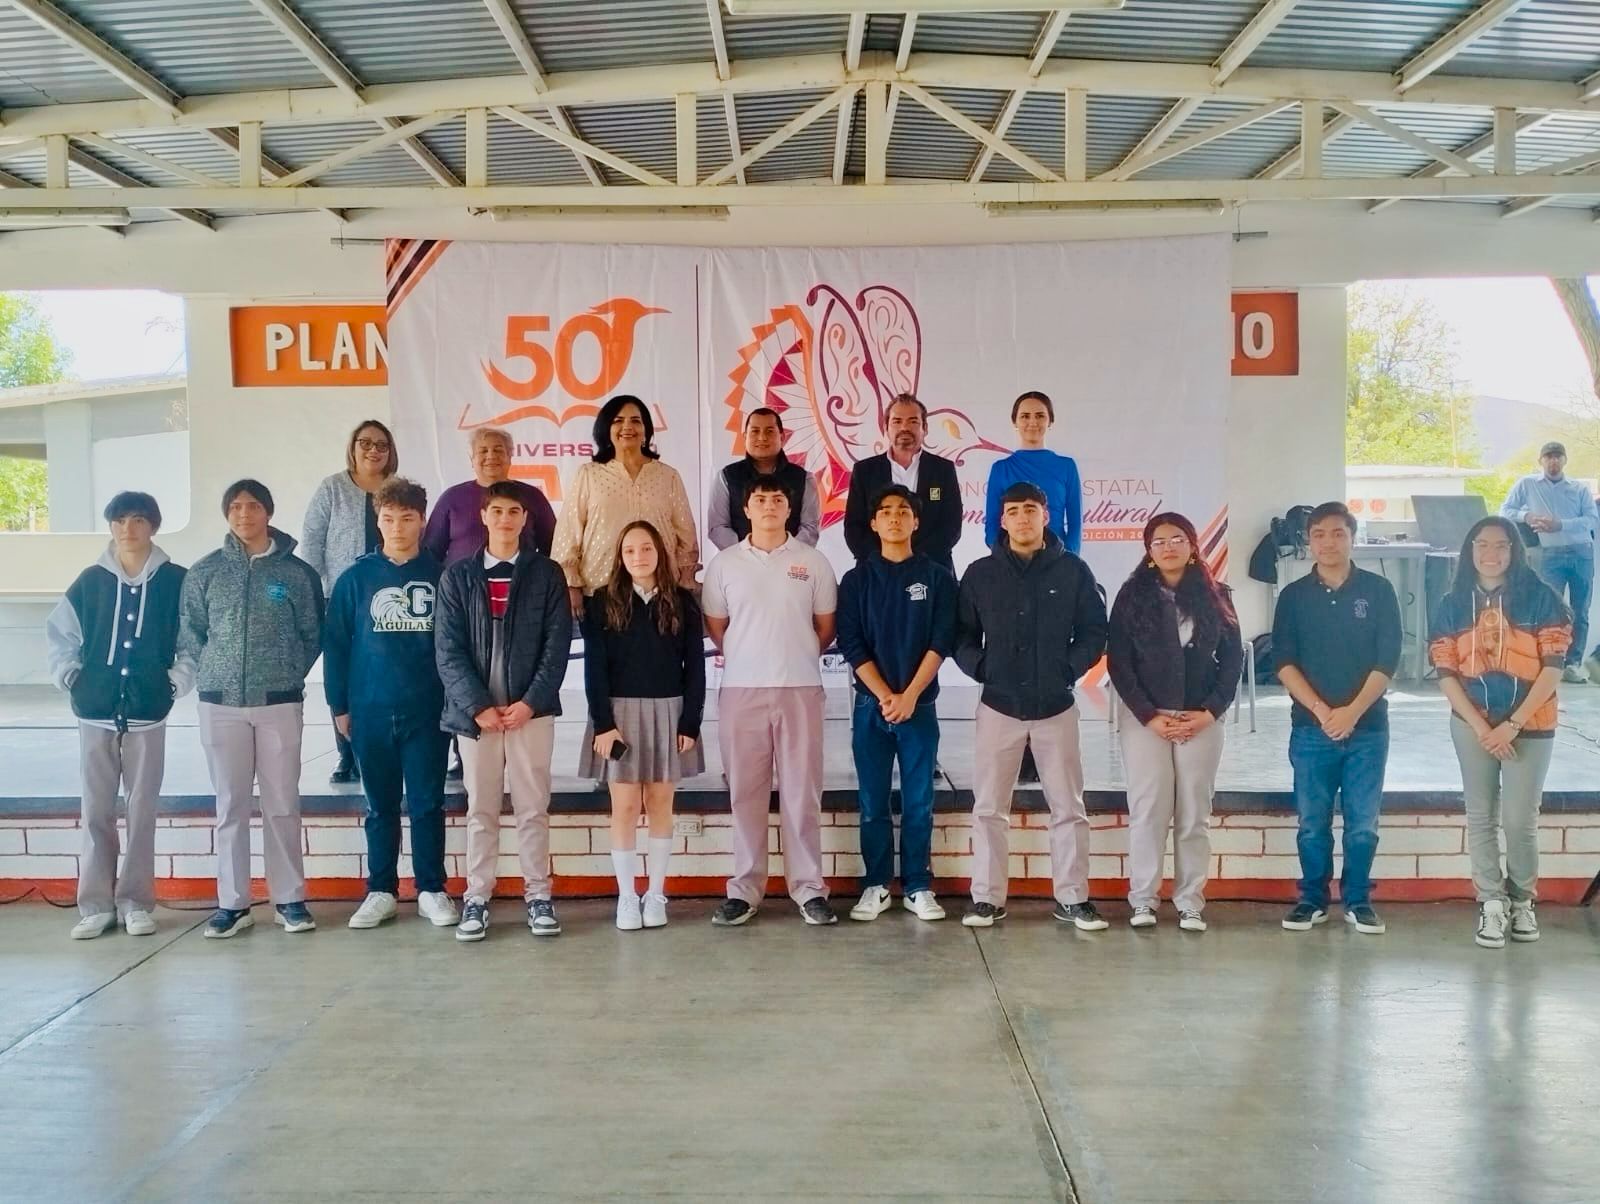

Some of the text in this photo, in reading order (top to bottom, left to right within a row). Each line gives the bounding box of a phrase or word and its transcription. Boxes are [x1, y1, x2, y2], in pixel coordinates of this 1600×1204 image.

[481, 308, 637, 401] 50
[1082, 479, 1163, 496] STATAL
[403, 581, 435, 620] G
[375, 621, 433, 631] AGUILAS
